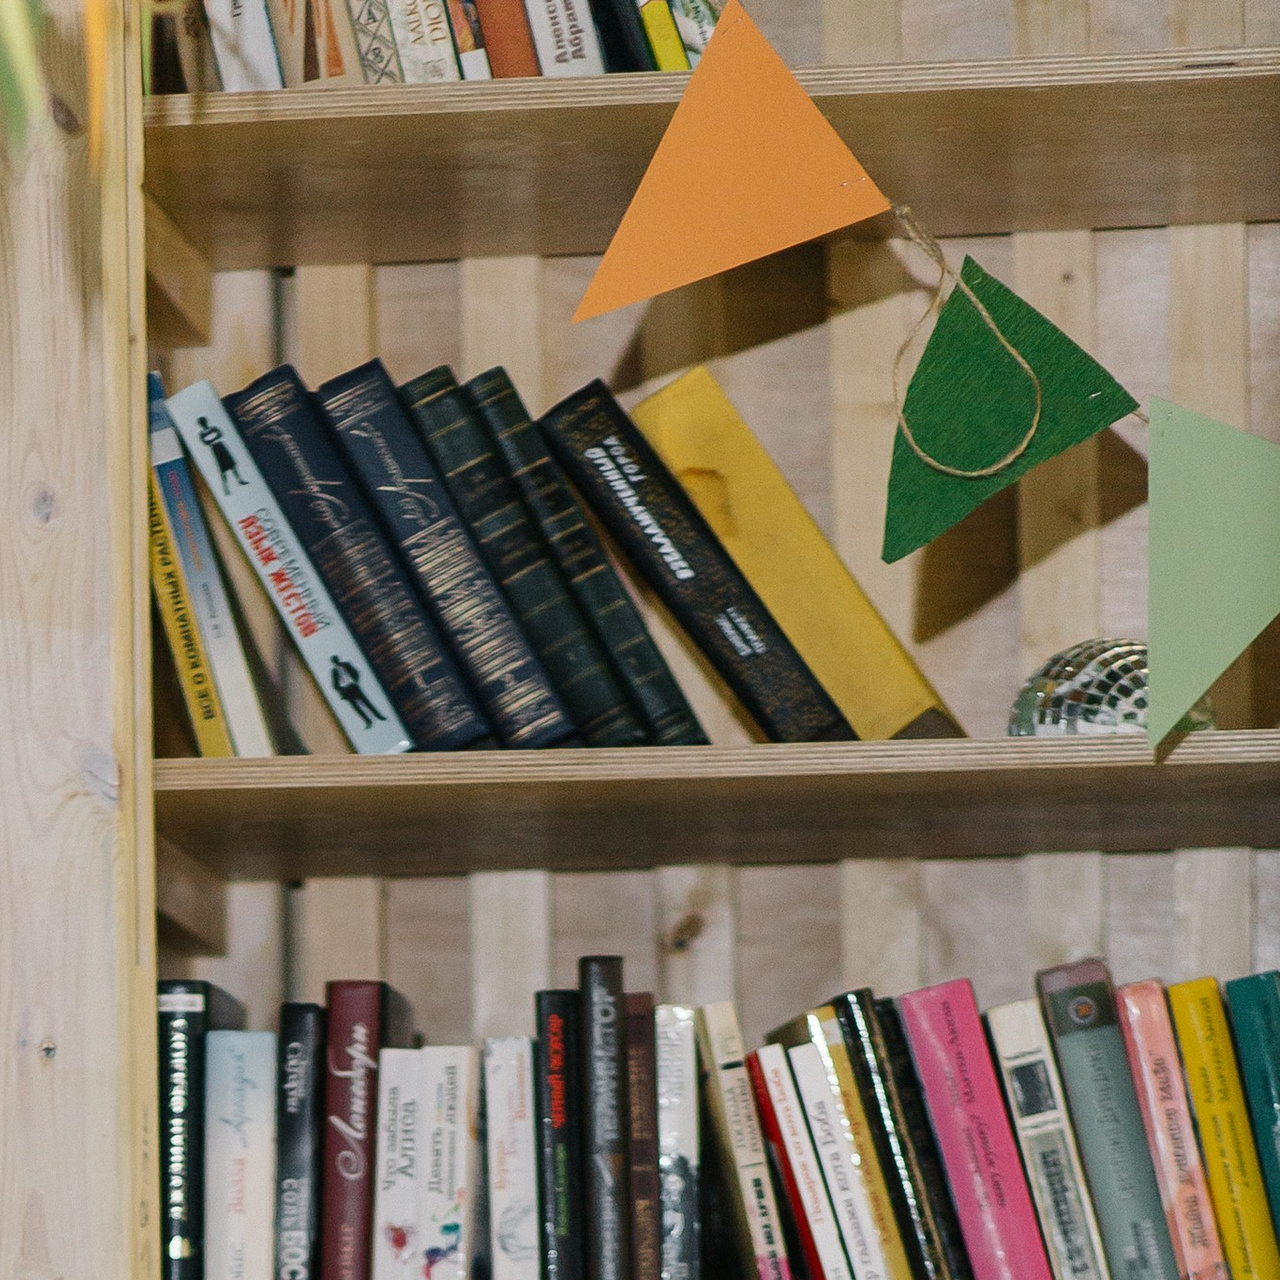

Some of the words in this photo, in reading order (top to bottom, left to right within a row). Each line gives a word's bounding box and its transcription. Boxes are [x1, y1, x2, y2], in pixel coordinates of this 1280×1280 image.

[601, 433, 647, 486] ГОРОД
[237, 511, 279, 568] ЯЗЫК
[267, 565, 319, 640] ЖЕСТОВ
[164, 566, 202, 670] КОМНАТНЫХ
[191, 671, 206, 685] О
[196, 688, 215, 720] ВСЕ
[397, 1100, 417, 1177] Алиса
[827, 1151, 850, 1193] кота
